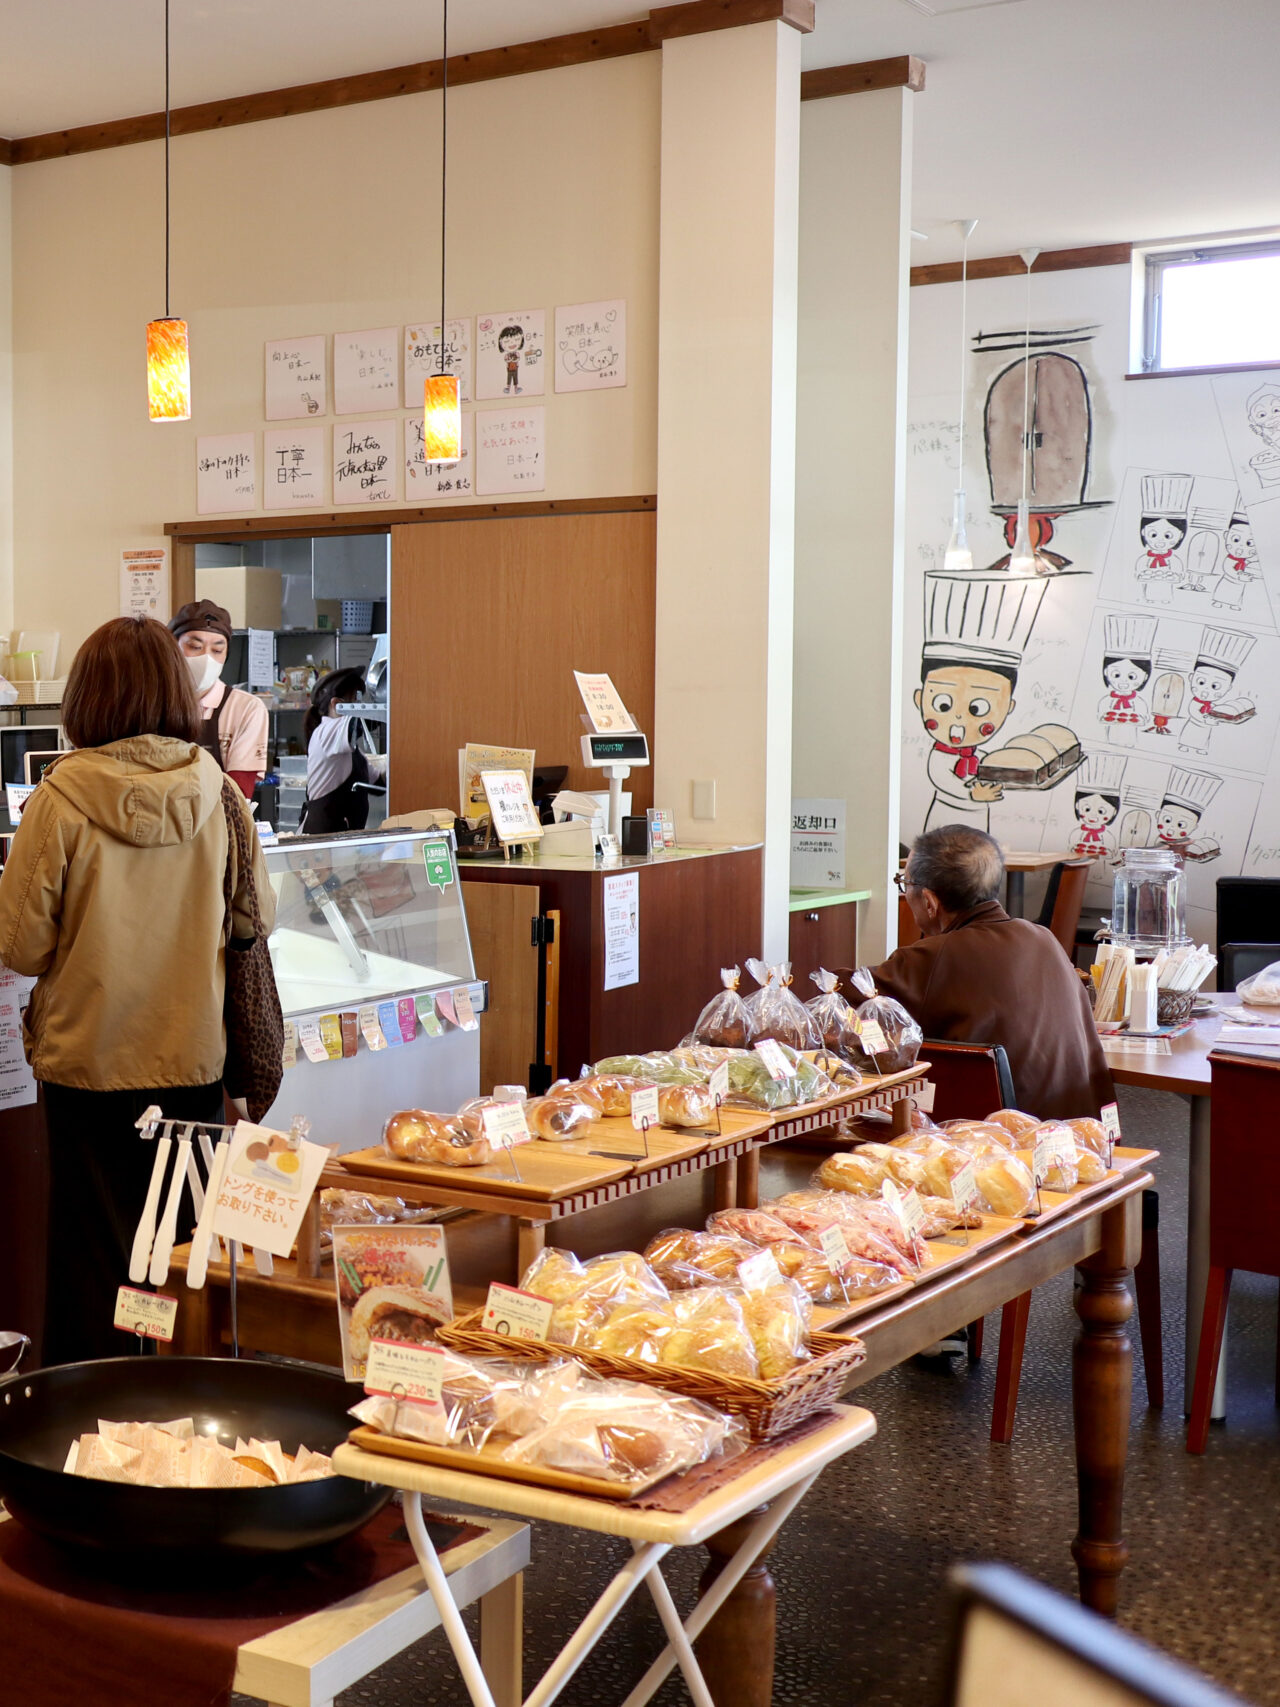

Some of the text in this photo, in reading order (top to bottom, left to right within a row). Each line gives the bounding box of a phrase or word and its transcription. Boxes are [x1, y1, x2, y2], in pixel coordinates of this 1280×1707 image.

[414, 342, 460, 358] おもてなし
[435, 356, 462, 369] 日本一
[277, 467, 313, 484] 日本一
[792, 815, 837, 830] 返却口
[224, 1175, 300, 1212] トングを使って
[217, 1193, 288, 1229] お取り下さい。
